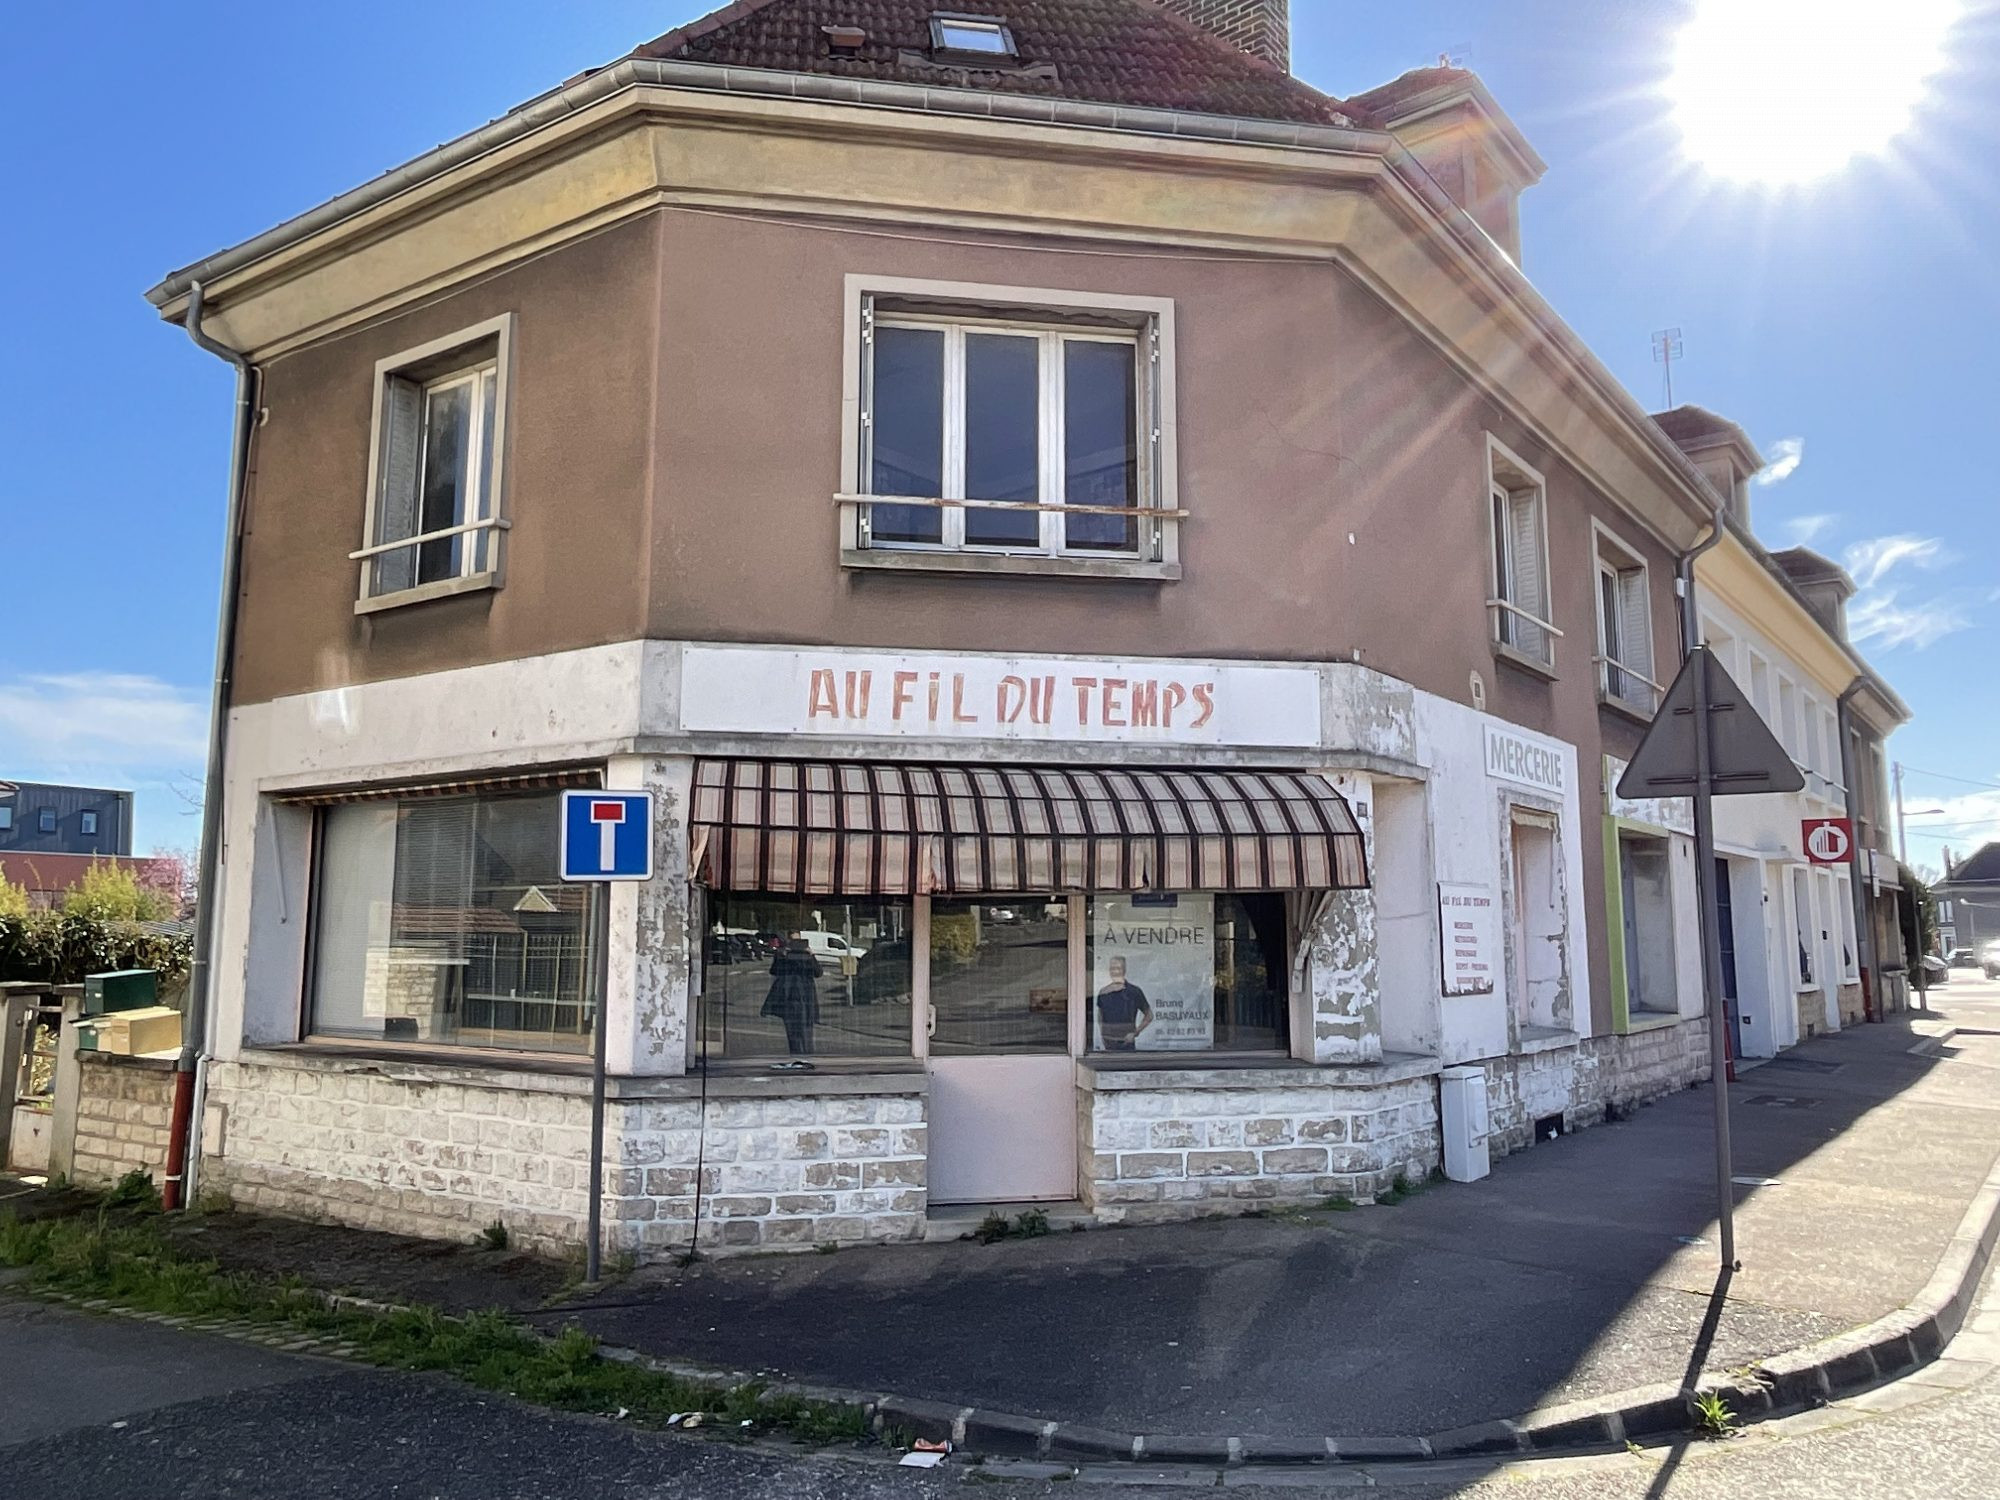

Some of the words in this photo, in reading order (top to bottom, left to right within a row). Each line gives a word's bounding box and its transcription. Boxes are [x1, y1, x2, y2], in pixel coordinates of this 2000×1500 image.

[809, 668, 872, 719] AU
[997, 675, 1055, 724] DU
[1072, 677, 1214, 728] TEMPS
[1490, 733, 1562, 788] MERCERIE
[1103, 923, 1117, 944] À
[1123, 927, 1205, 945] VENDRE
